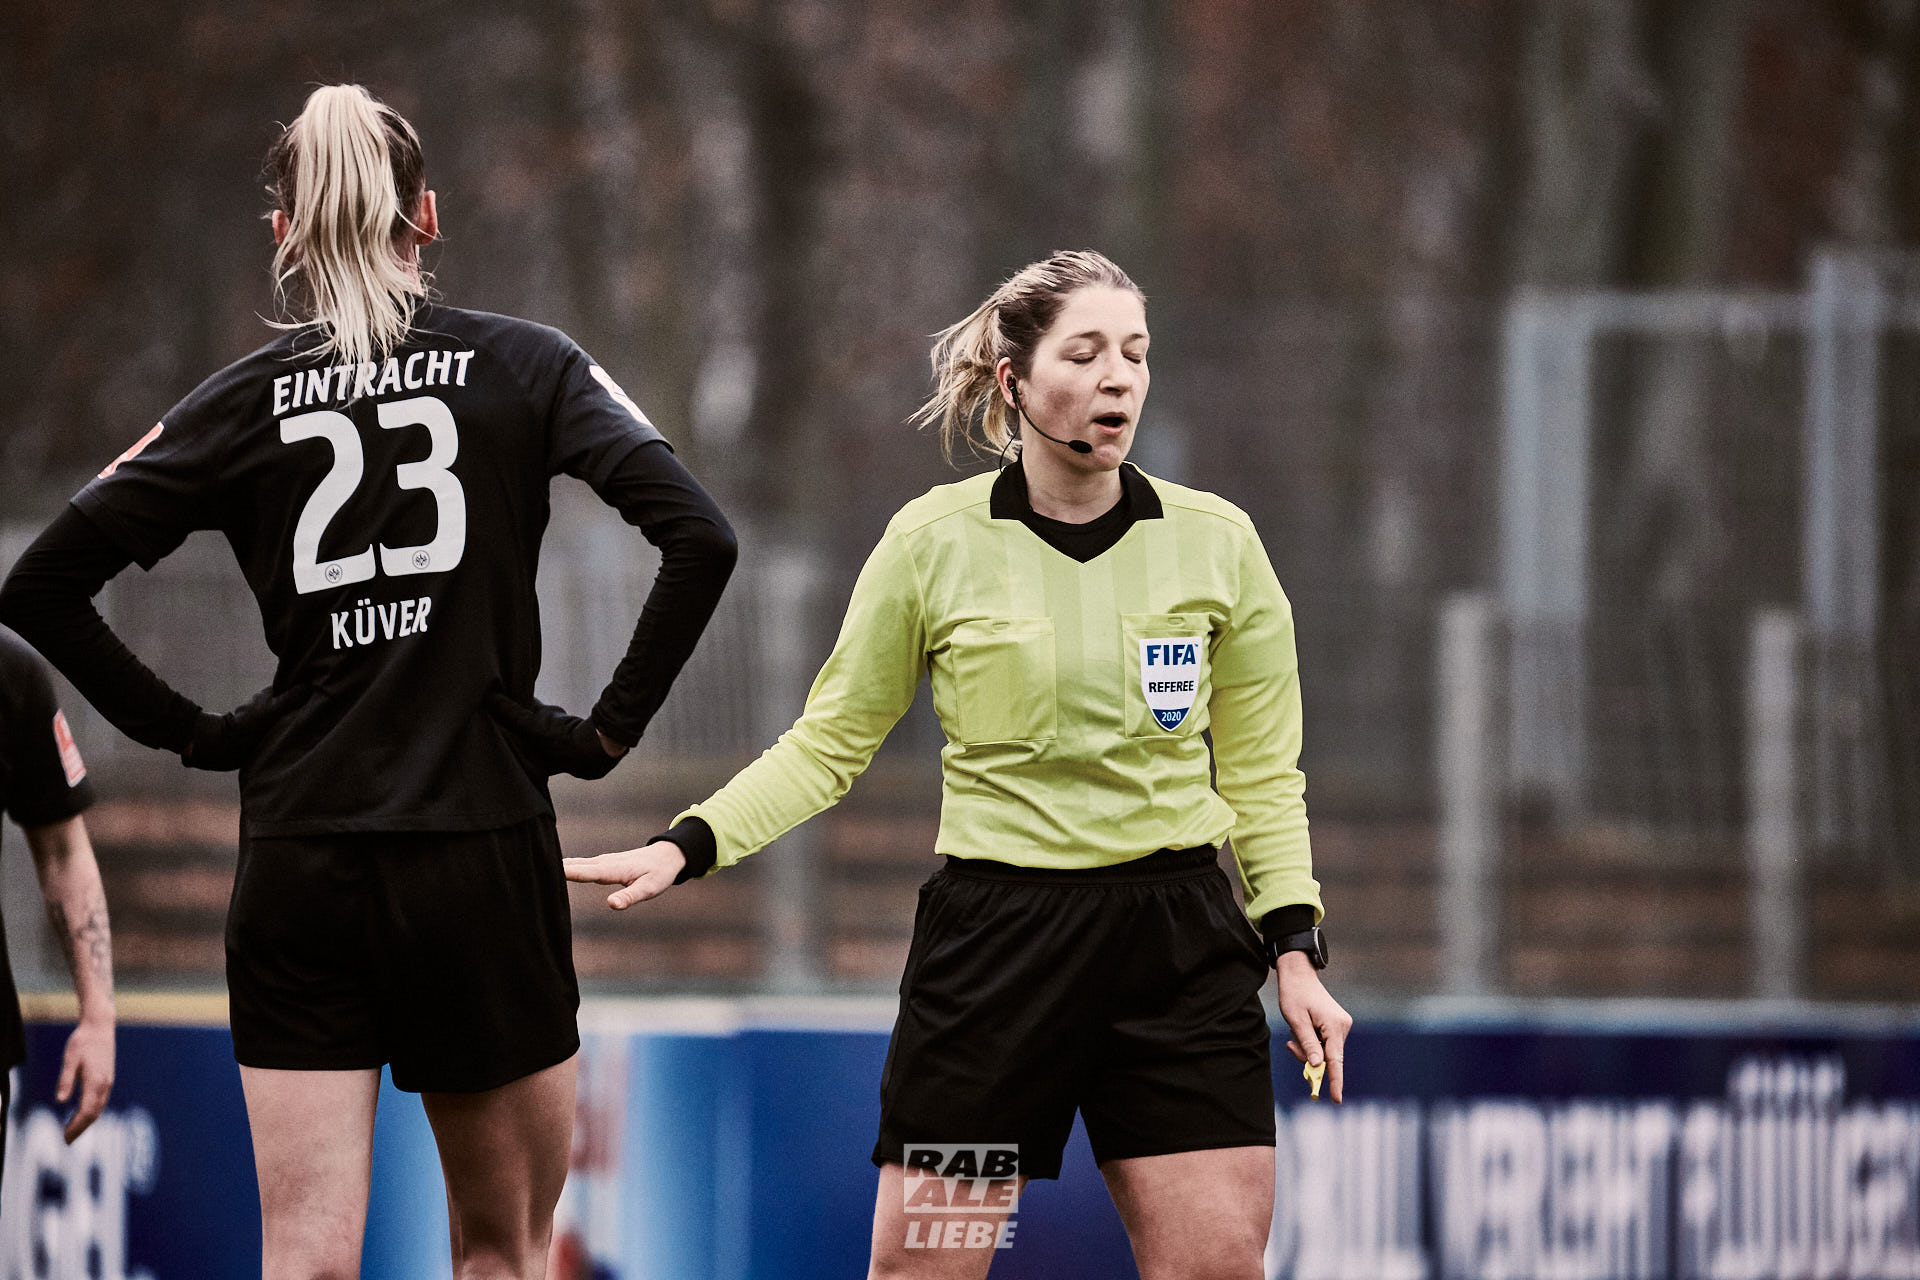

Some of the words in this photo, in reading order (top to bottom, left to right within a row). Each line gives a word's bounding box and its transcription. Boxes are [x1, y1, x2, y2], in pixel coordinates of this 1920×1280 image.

[273, 349, 475, 416] EINTRACHT
[280, 395, 467, 595] 23
[331, 596, 432, 649] KÜVER
[1146, 643, 1197, 666] FIFA
[1148, 680, 1194, 693] REFEREE
[1161, 711, 1181, 722] 2020
